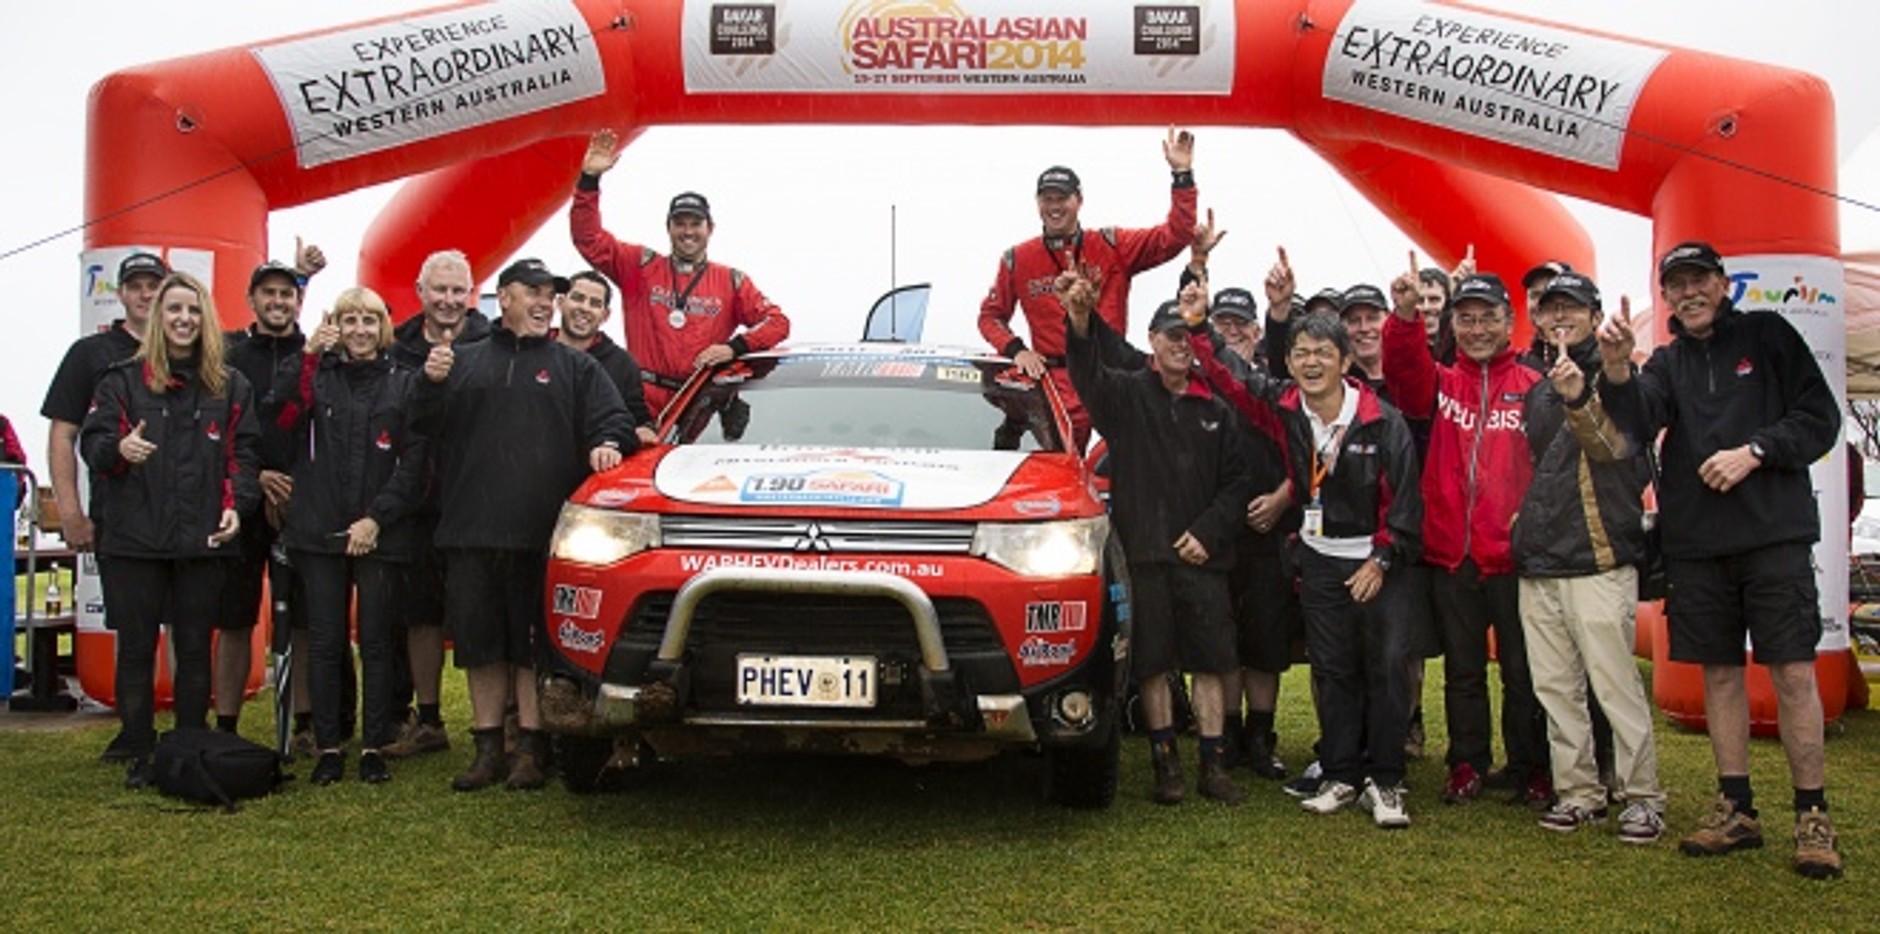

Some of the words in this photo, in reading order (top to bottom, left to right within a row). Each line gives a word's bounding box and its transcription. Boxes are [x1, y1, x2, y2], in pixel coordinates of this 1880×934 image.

[352, 14, 508, 63] EXPERIENCE
[852, 17, 1087, 39] AUSTRALASIAN
[1412, 15, 1569, 60] EXPERIENCE
[299, 24, 580, 116] EXTRAORDINARY
[963, 73, 1020, 84] WESTERN
[1022, 73, 1087, 84] AUSTRALIA
[1341, 26, 1621, 115] EXTRAORDINARY
[333, 103, 446, 138] WESTERN
[454, 68, 573, 110] AUSTRALIA
[1351, 69, 1446, 106] WESTERN
[1453, 95, 1581, 140] AUSTRALIA
[743, 667, 813, 696] PHEV
[843, 669, 867, 698] 11
